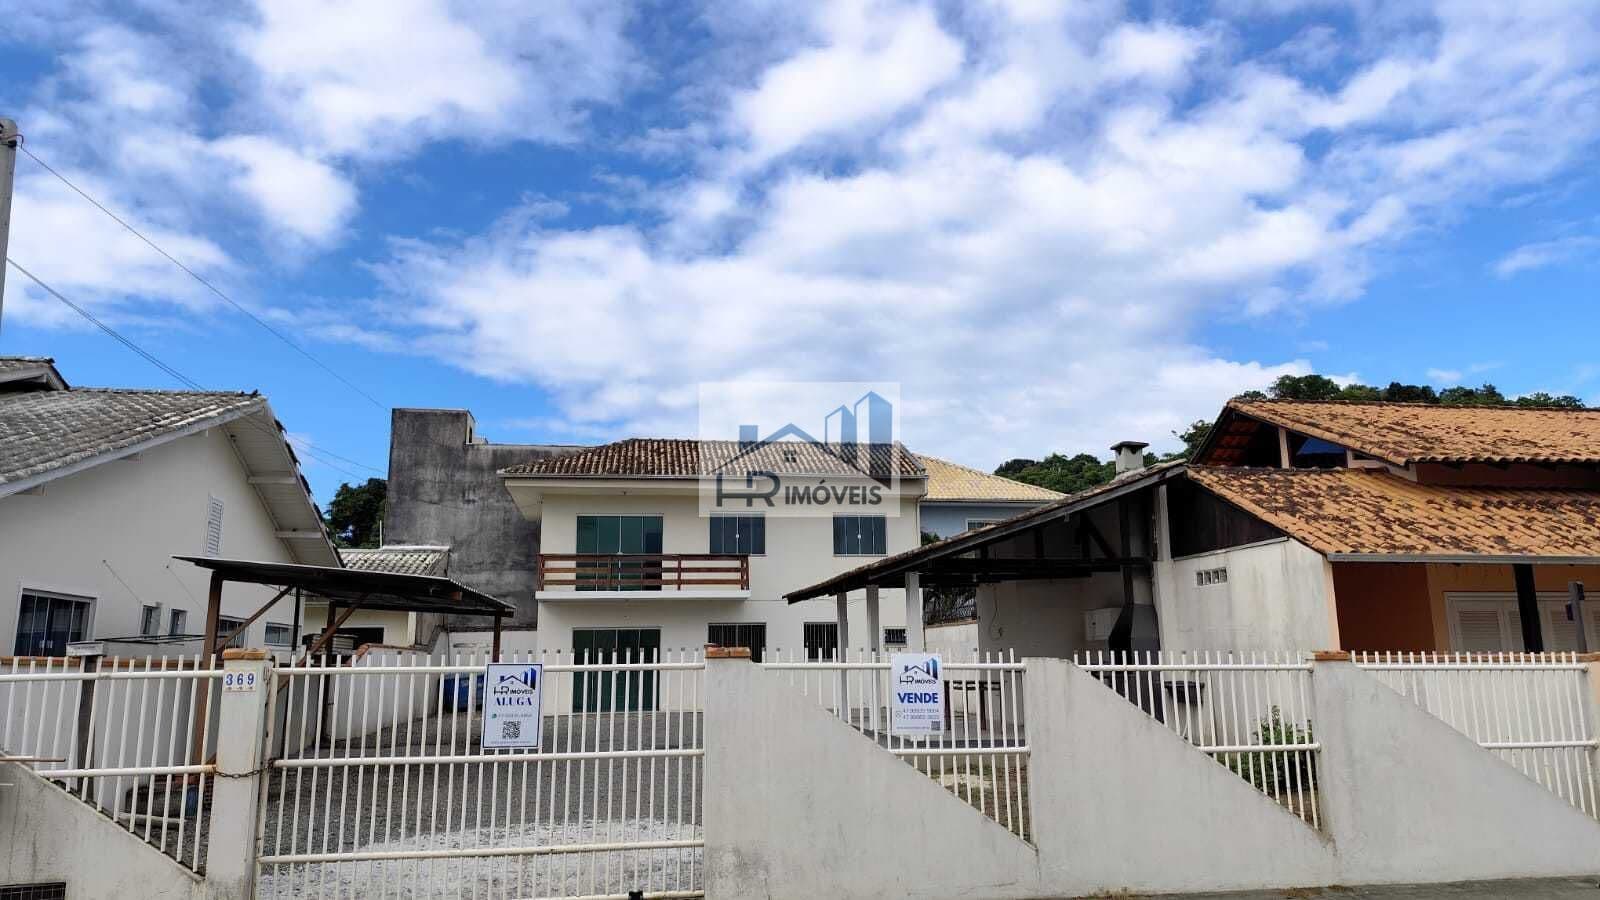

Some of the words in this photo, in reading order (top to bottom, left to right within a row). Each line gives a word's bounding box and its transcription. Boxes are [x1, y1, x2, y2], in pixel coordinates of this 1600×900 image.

[226, 673, 254, 686] 369
[495, 697, 532, 705] ALUGA
[897, 692, 938, 703] VENDE
